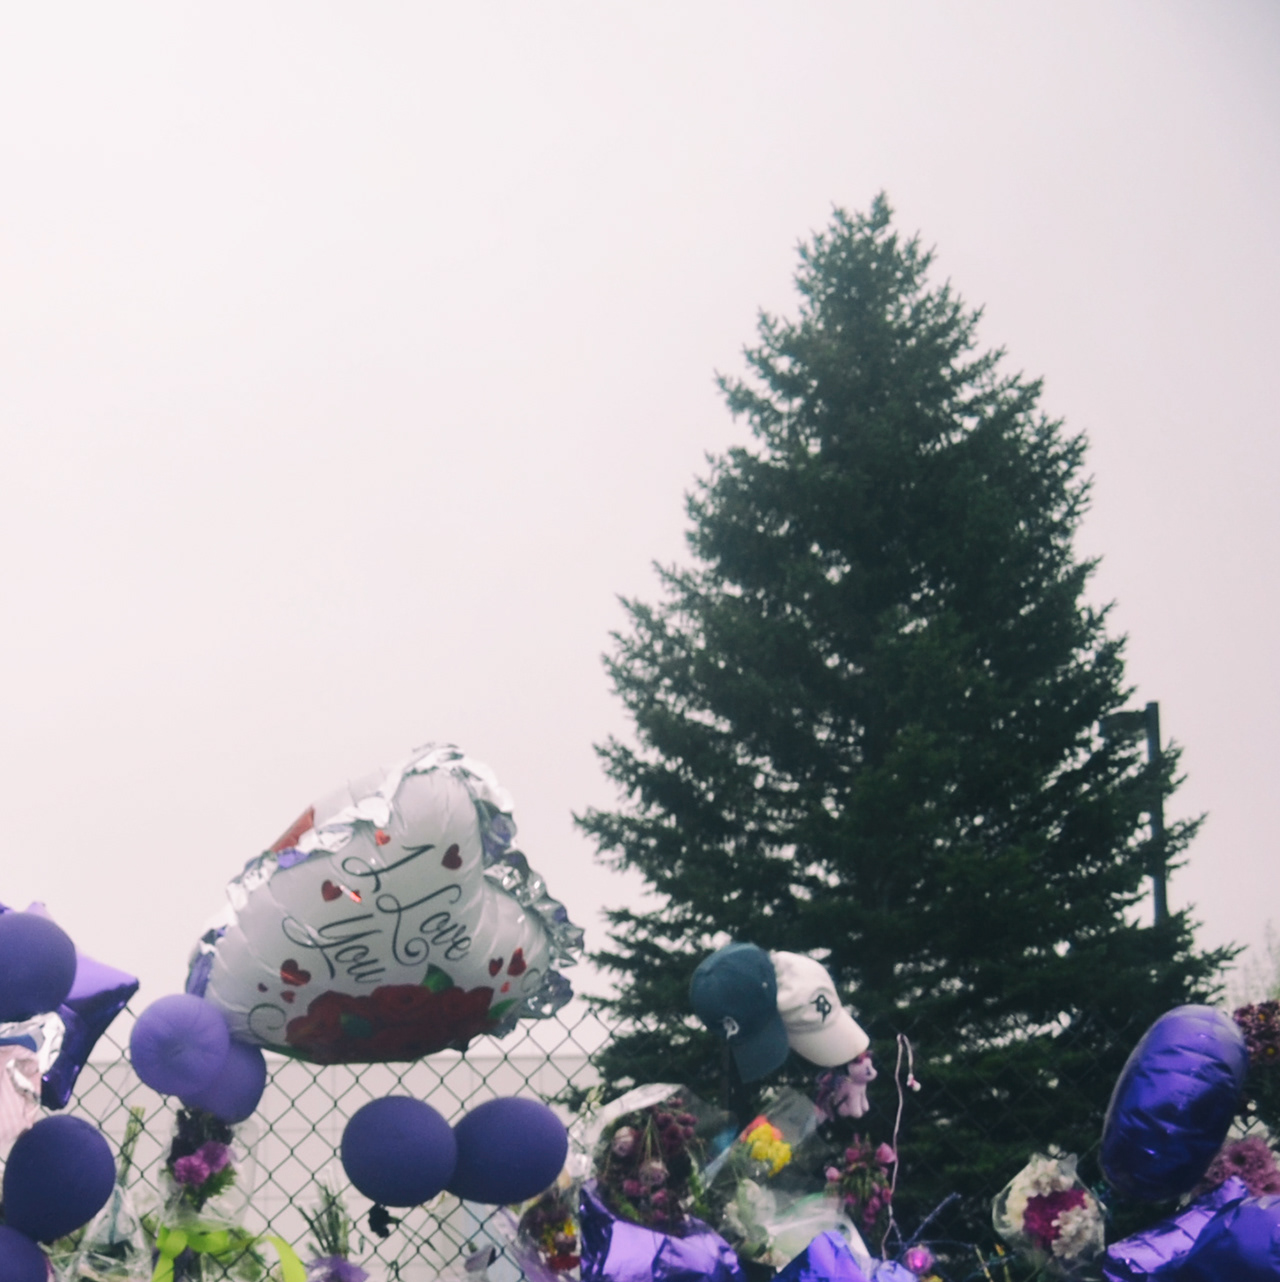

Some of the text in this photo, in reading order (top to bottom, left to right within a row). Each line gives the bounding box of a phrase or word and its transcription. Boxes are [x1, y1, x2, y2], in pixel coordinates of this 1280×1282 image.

[341, 844, 435, 893] I
[281, 913, 386, 983] You
[375, 883, 472, 966] Love
